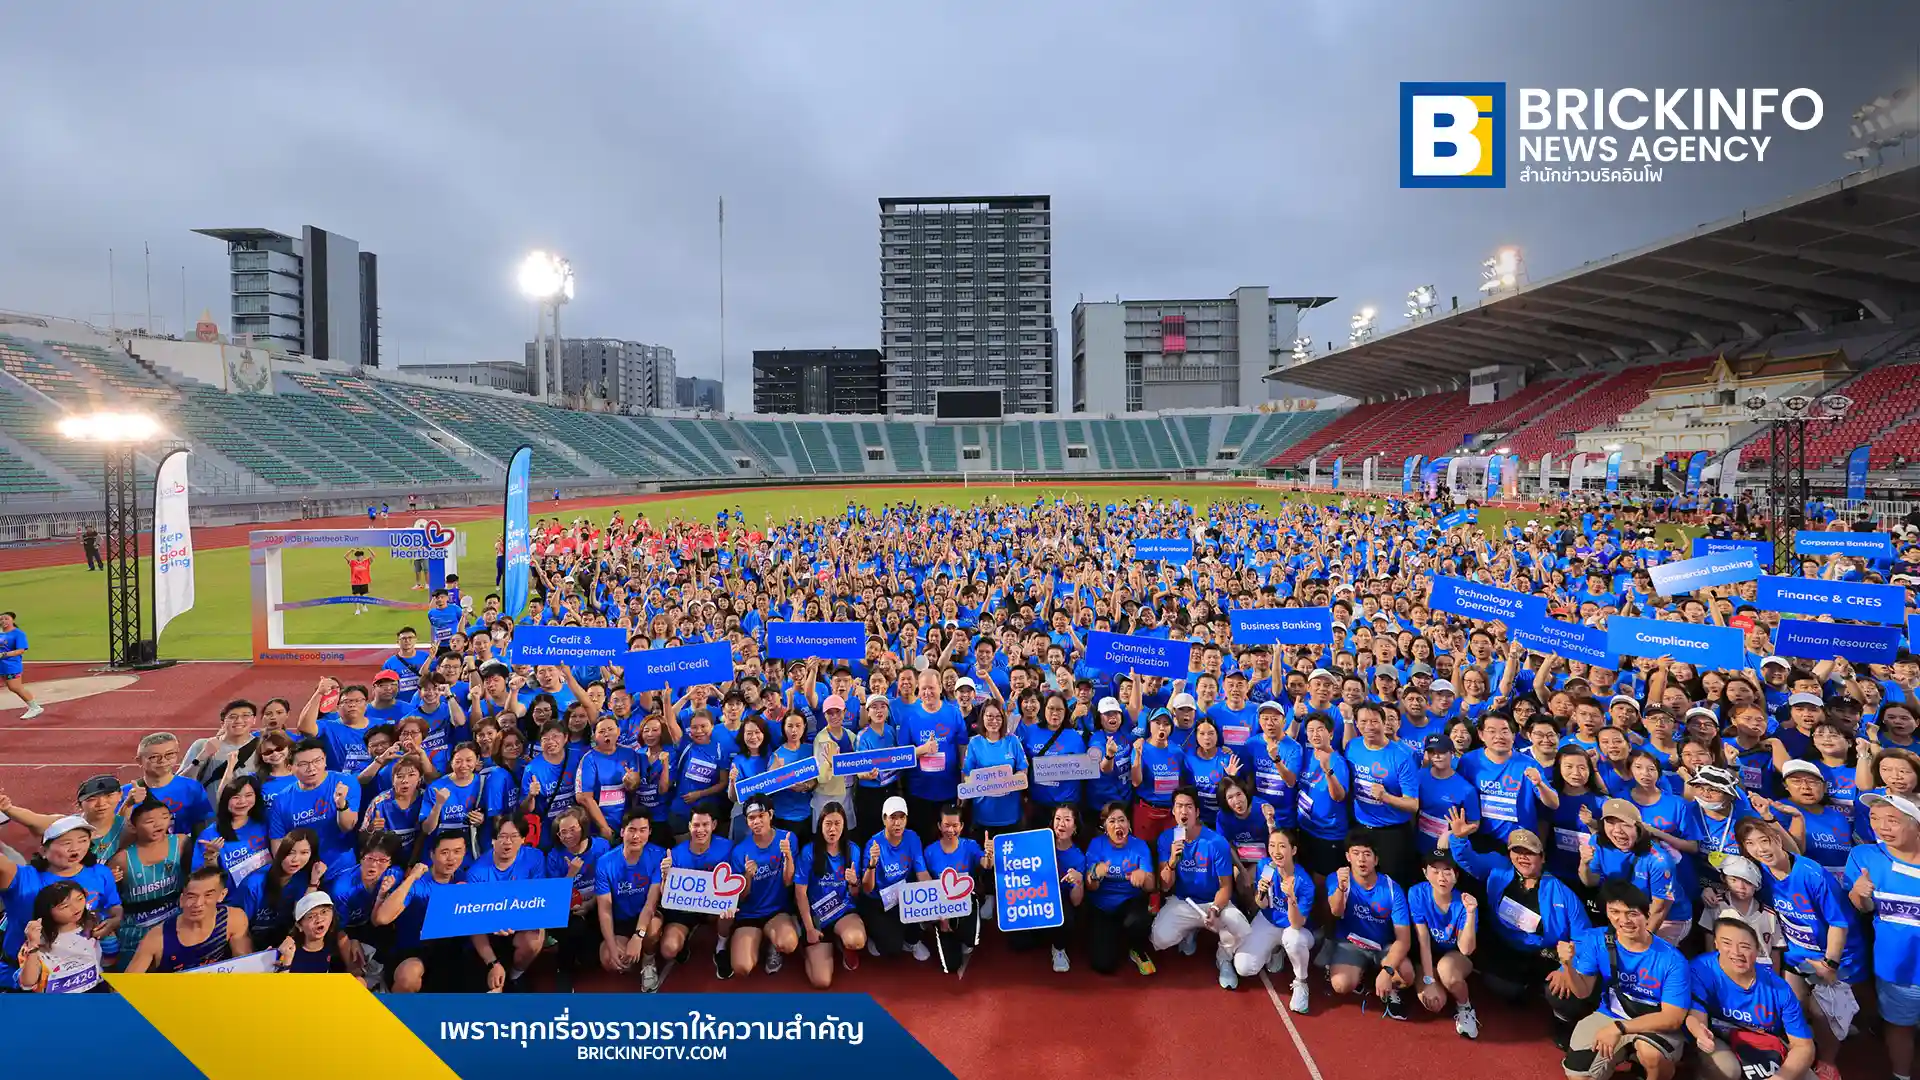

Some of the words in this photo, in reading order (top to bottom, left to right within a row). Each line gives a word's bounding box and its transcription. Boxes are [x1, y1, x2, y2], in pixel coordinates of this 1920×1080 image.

[390, 533, 423, 547] UOB
[1800, 539, 1845, 549] Corporate
[1846, 540, 1884, 549] Banking
[390, 547, 448, 559] Heartbeat
[1711, 559, 1754, 575] Banking
[1453, 585, 1513, 608] Technology
[1514, 600, 1524, 609] &
[1777, 589, 1828, 603] Finance
[1832, 595, 1842, 604] &
[1846, 596, 1882, 607] CRES
[1456, 597, 1516, 618] Operations
[1240, 621, 1279, 632] Business
[1281, 620, 1322, 633] Banking
[549, 634, 580, 645] Credit
[583, 635, 592, 645] &
[775, 635, 794, 644] Risk
[795, 635, 857, 646] Management
[1513, 628, 1560, 646] Financial
[1561, 640, 1606, 658] Services
[1635, 632, 1710, 650] Compliance
[1787, 633, 1829, 646] Human
[1832, 639, 1888, 650] Resources
[522, 646, 544, 655] Risk
[545, 646, 616, 658] Management
[1111, 641, 1155, 655] Channels
[1158, 647, 1165, 656] &
[647, 662, 677, 675] Retail
[678, 658, 710, 670] Credit
[1105, 651, 1170, 668] Digitalisation
[1035, 762, 1080, 771] Volunteering
[975, 770, 997, 781] Right
[959, 785, 975, 795] Our
[976, 780, 1026, 793] Communities
[1480, 779, 1501, 789] UOB
[293, 810, 315, 821] UOB
[1812, 832, 1836, 843] UOB
[224, 847, 248, 861] UOB
[1002, 840, 1014, 854] #
[884, 863, 900, 872] UOB
[1003, 856, 1042, 872] keep
[669, 875, 706, 893] UOB
[1004, 873, 1031, 888] the
[903, 887, 938, 905] UOB
[1005, 881, 1048, 905] good
[454, 899, 508, 915] Internal
[510, 896, 546, 910] Audit
[666, 893, 733, 910] Heartbeat
[822, 898, 839, 912] 3792
[1880, 902, 1893, 912] M
[904, 901, 968, 919] Heartbeat
[1006, 901, 1054, 922] going
[52, 981, 60, 991] F
[62, 970, 95, 988] 4420
[1722, 1007, 1753, 1022] UOB
